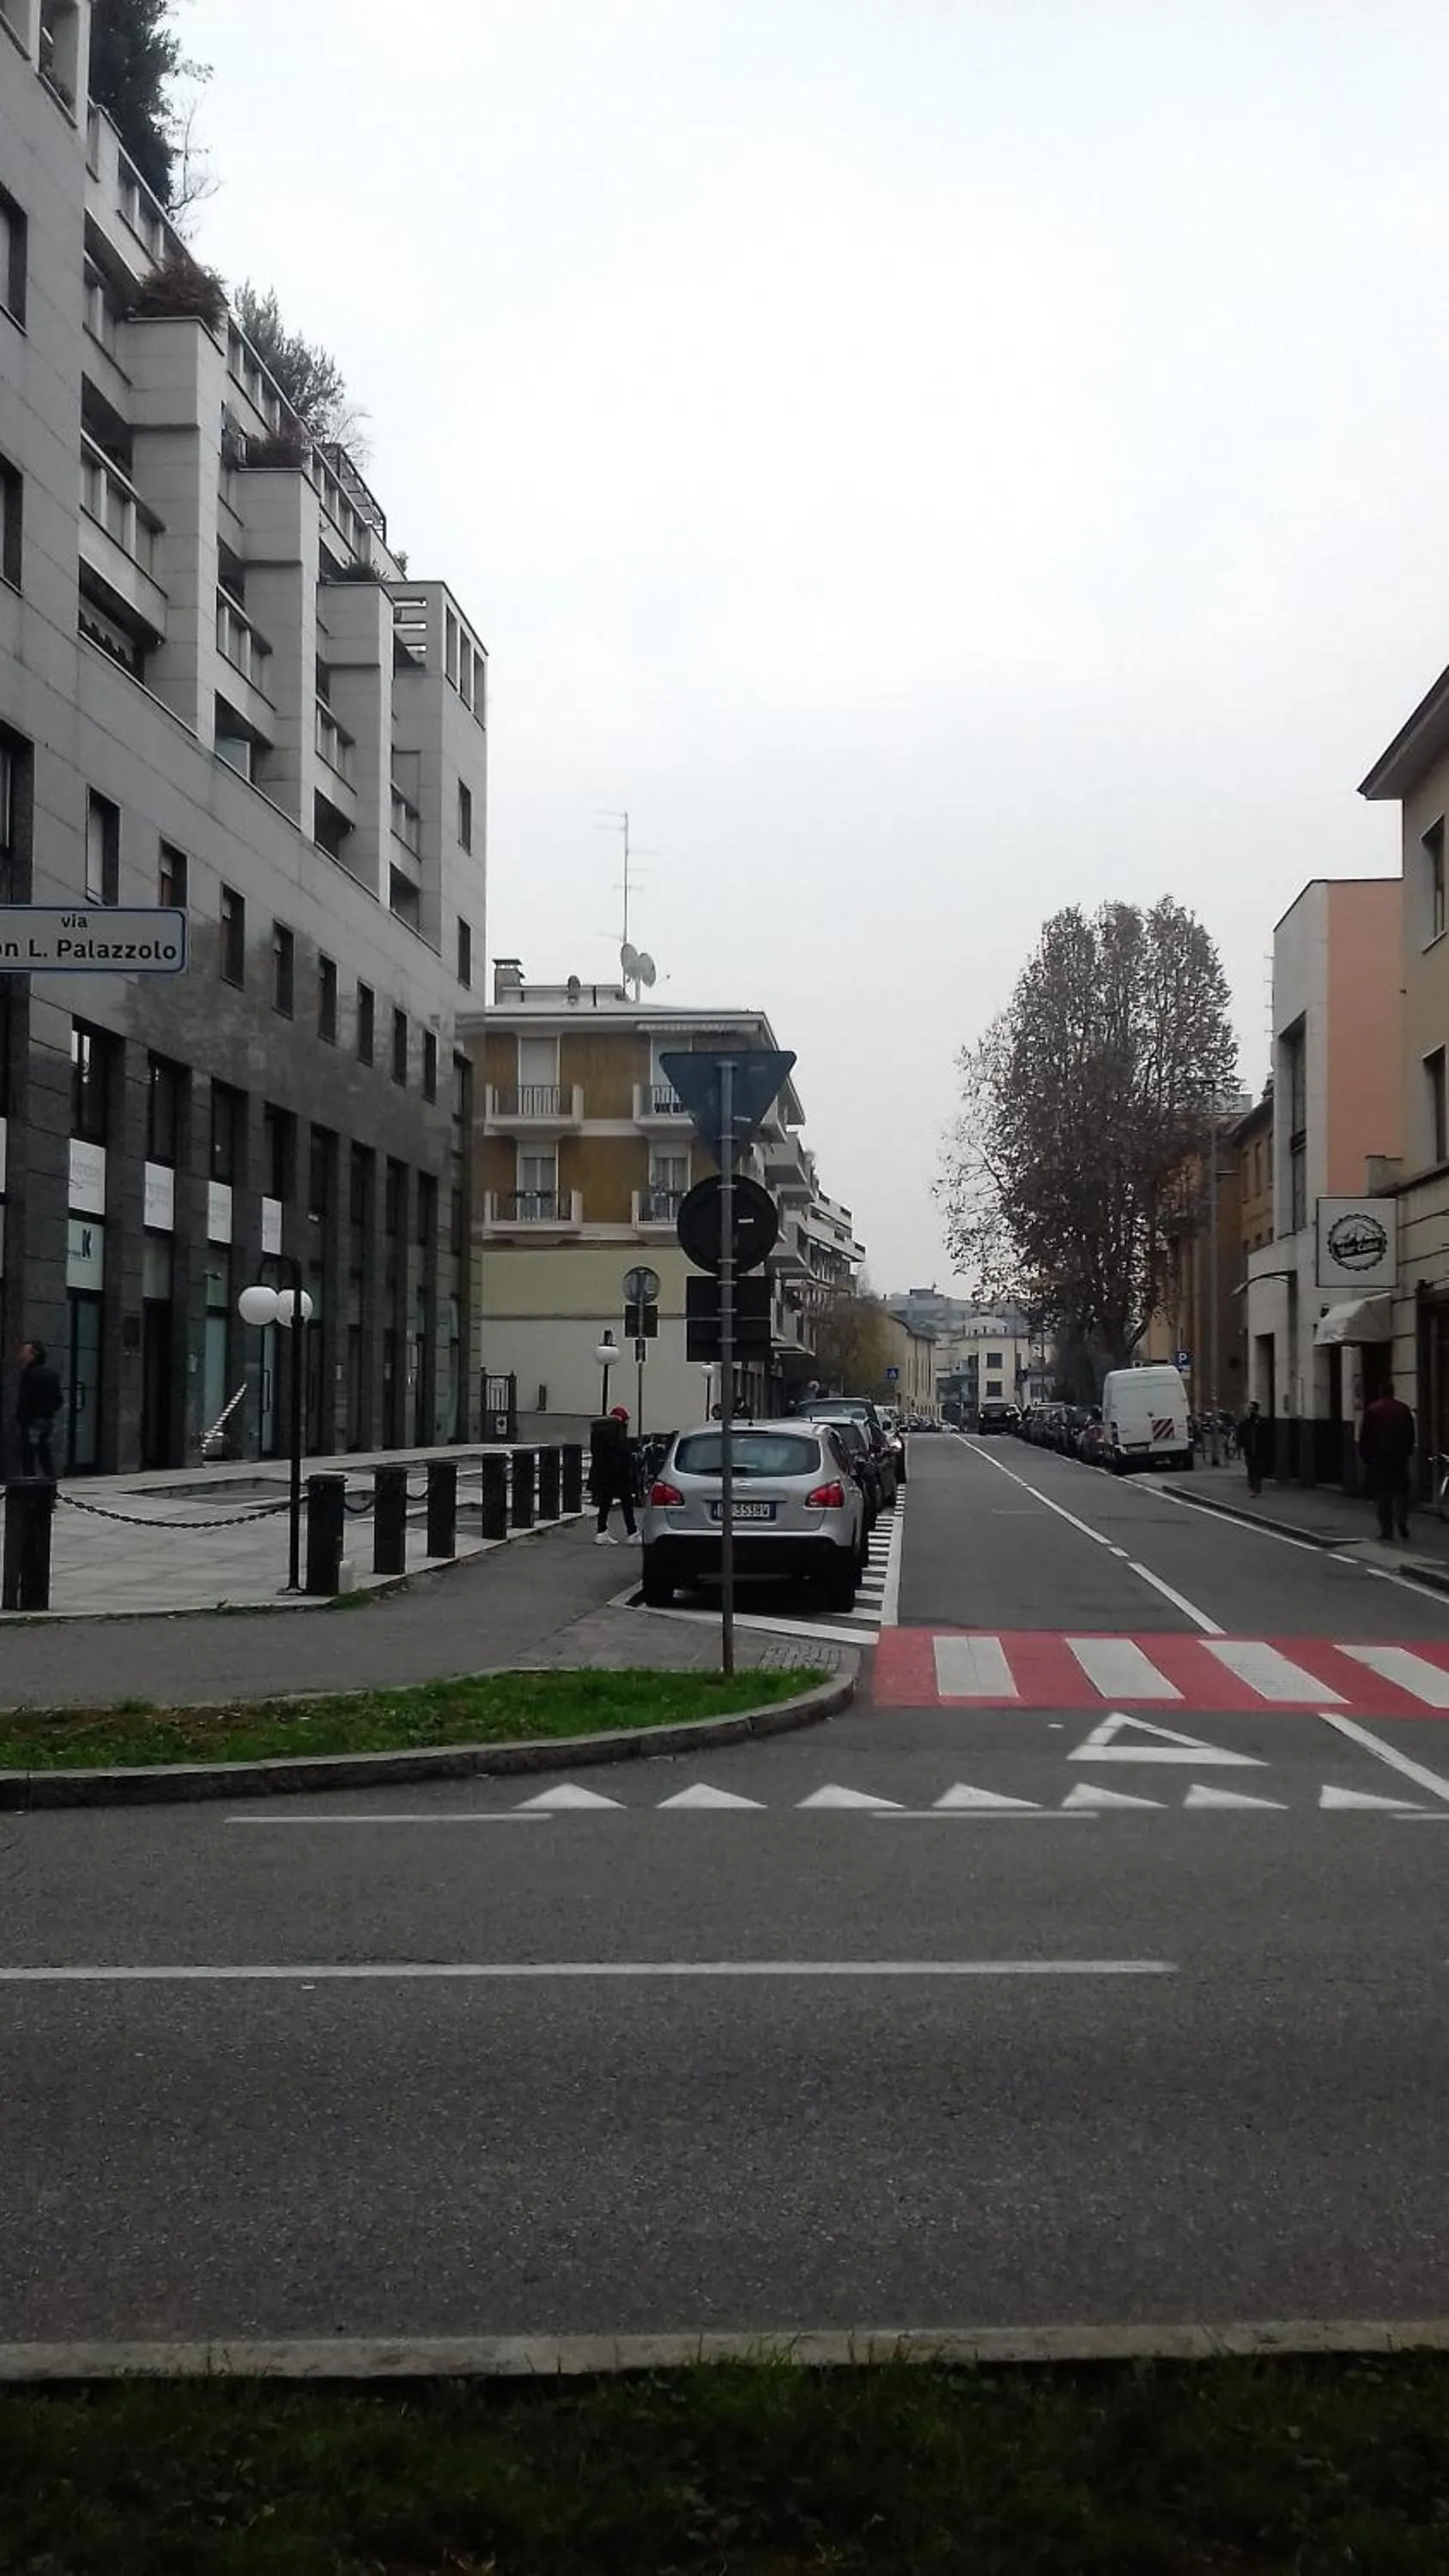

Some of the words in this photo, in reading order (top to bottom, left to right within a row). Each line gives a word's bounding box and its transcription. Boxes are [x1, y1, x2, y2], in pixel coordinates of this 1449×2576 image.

[61, 914, 88, 928] via
[28, 939, 47, 957] L.
[57, 939, 177, 960] Palazzolo
[1179, 1352, 1187, 1364] P
